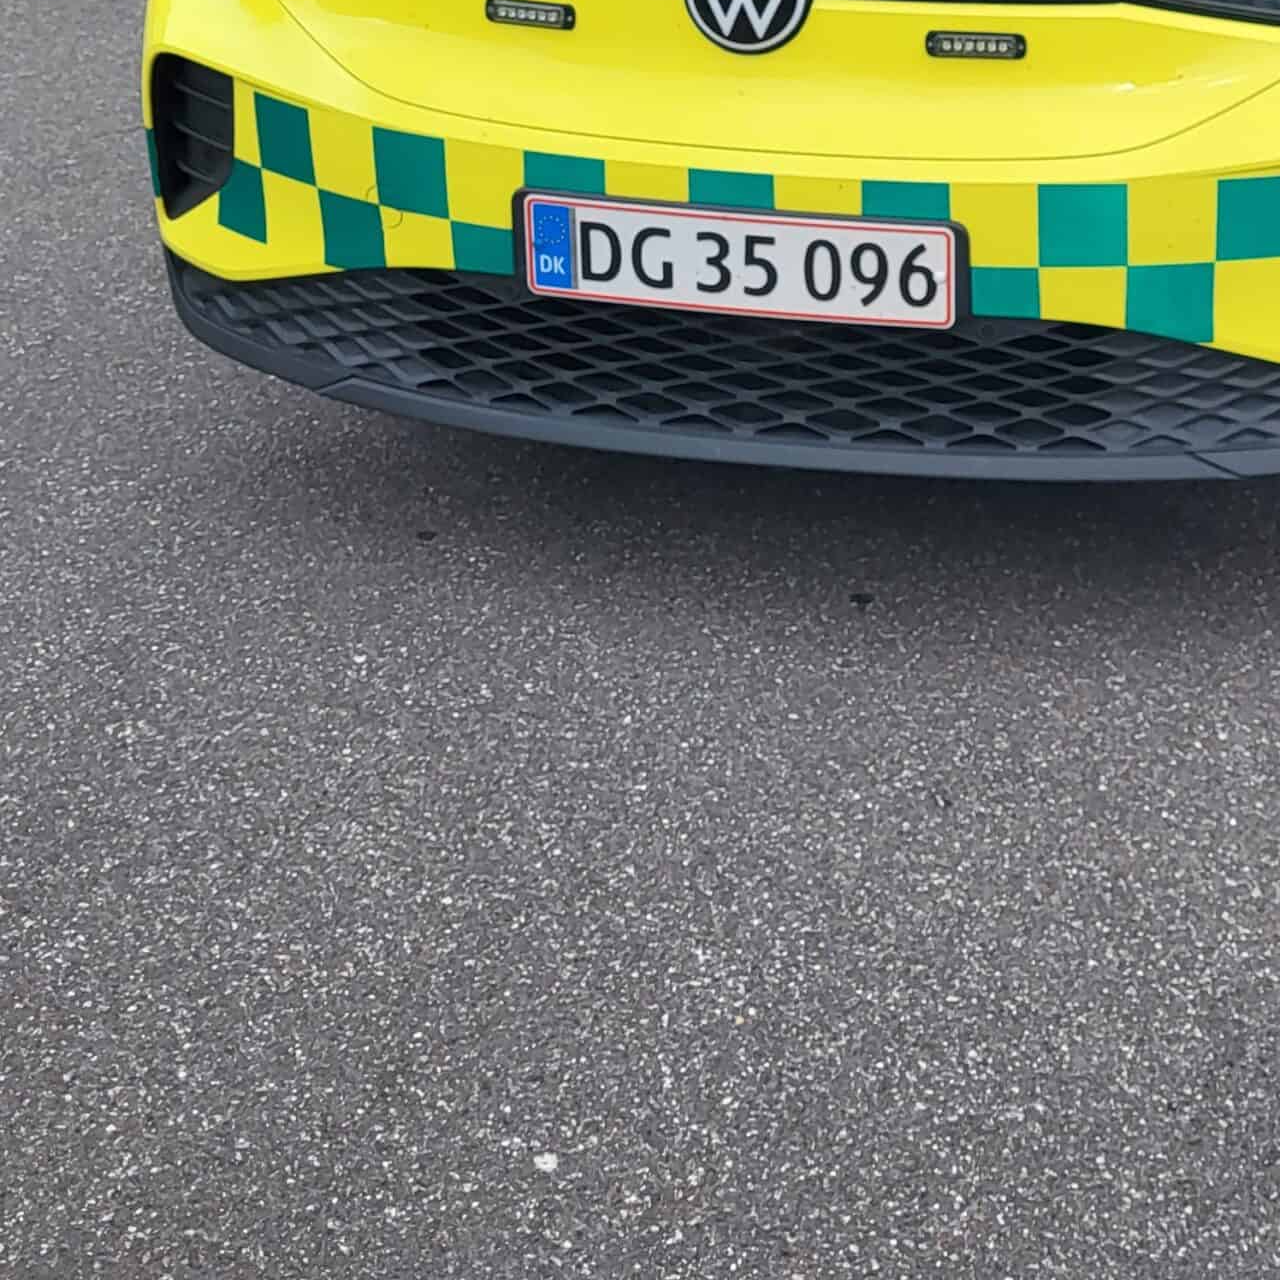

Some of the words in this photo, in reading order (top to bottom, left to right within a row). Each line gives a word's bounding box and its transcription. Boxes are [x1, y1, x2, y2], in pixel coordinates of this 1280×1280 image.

[540, 254, 566, 275] DK
[580, 221, 674, 289] DG
[697, 231, 778, 297] 35
[804, 239, 938, 308] 096
